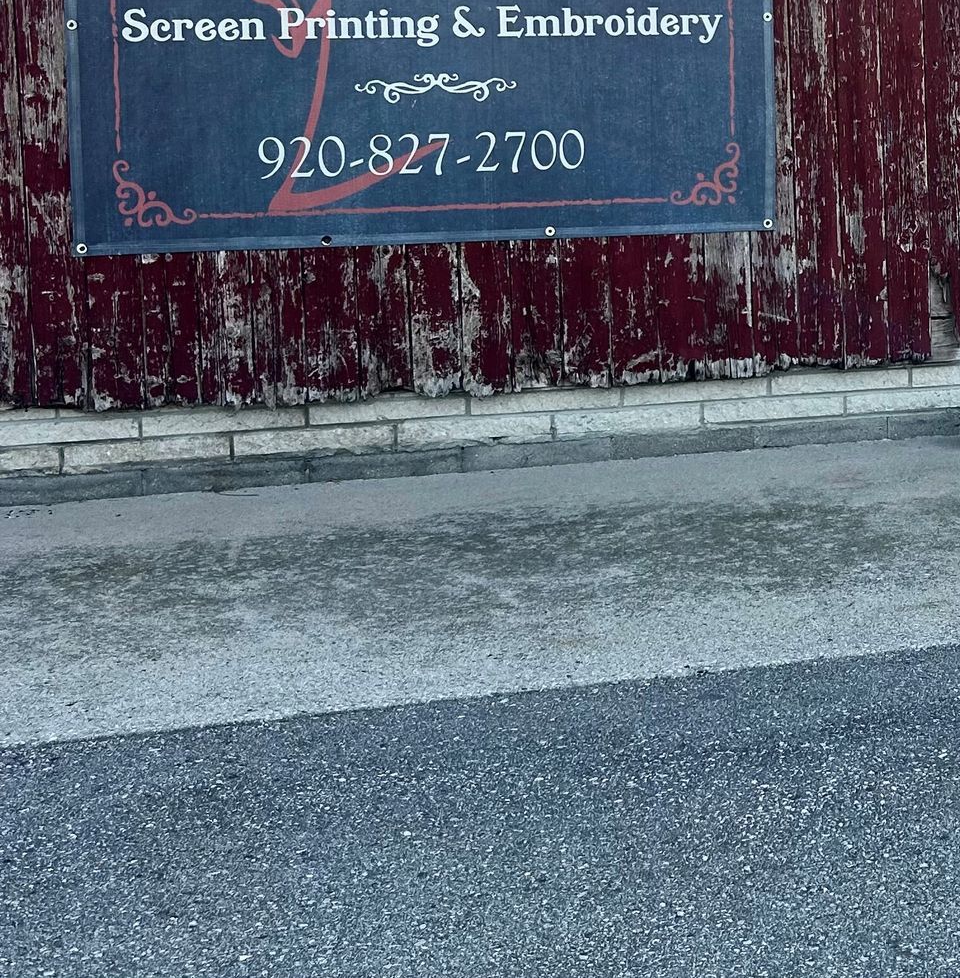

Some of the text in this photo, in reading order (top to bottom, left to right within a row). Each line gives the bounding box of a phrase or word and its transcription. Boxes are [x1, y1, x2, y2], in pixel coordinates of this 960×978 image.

[121, 4, 723, 47] Screen Printing & Embroidery
[258, 128, 586, 181] 920-827-2700
